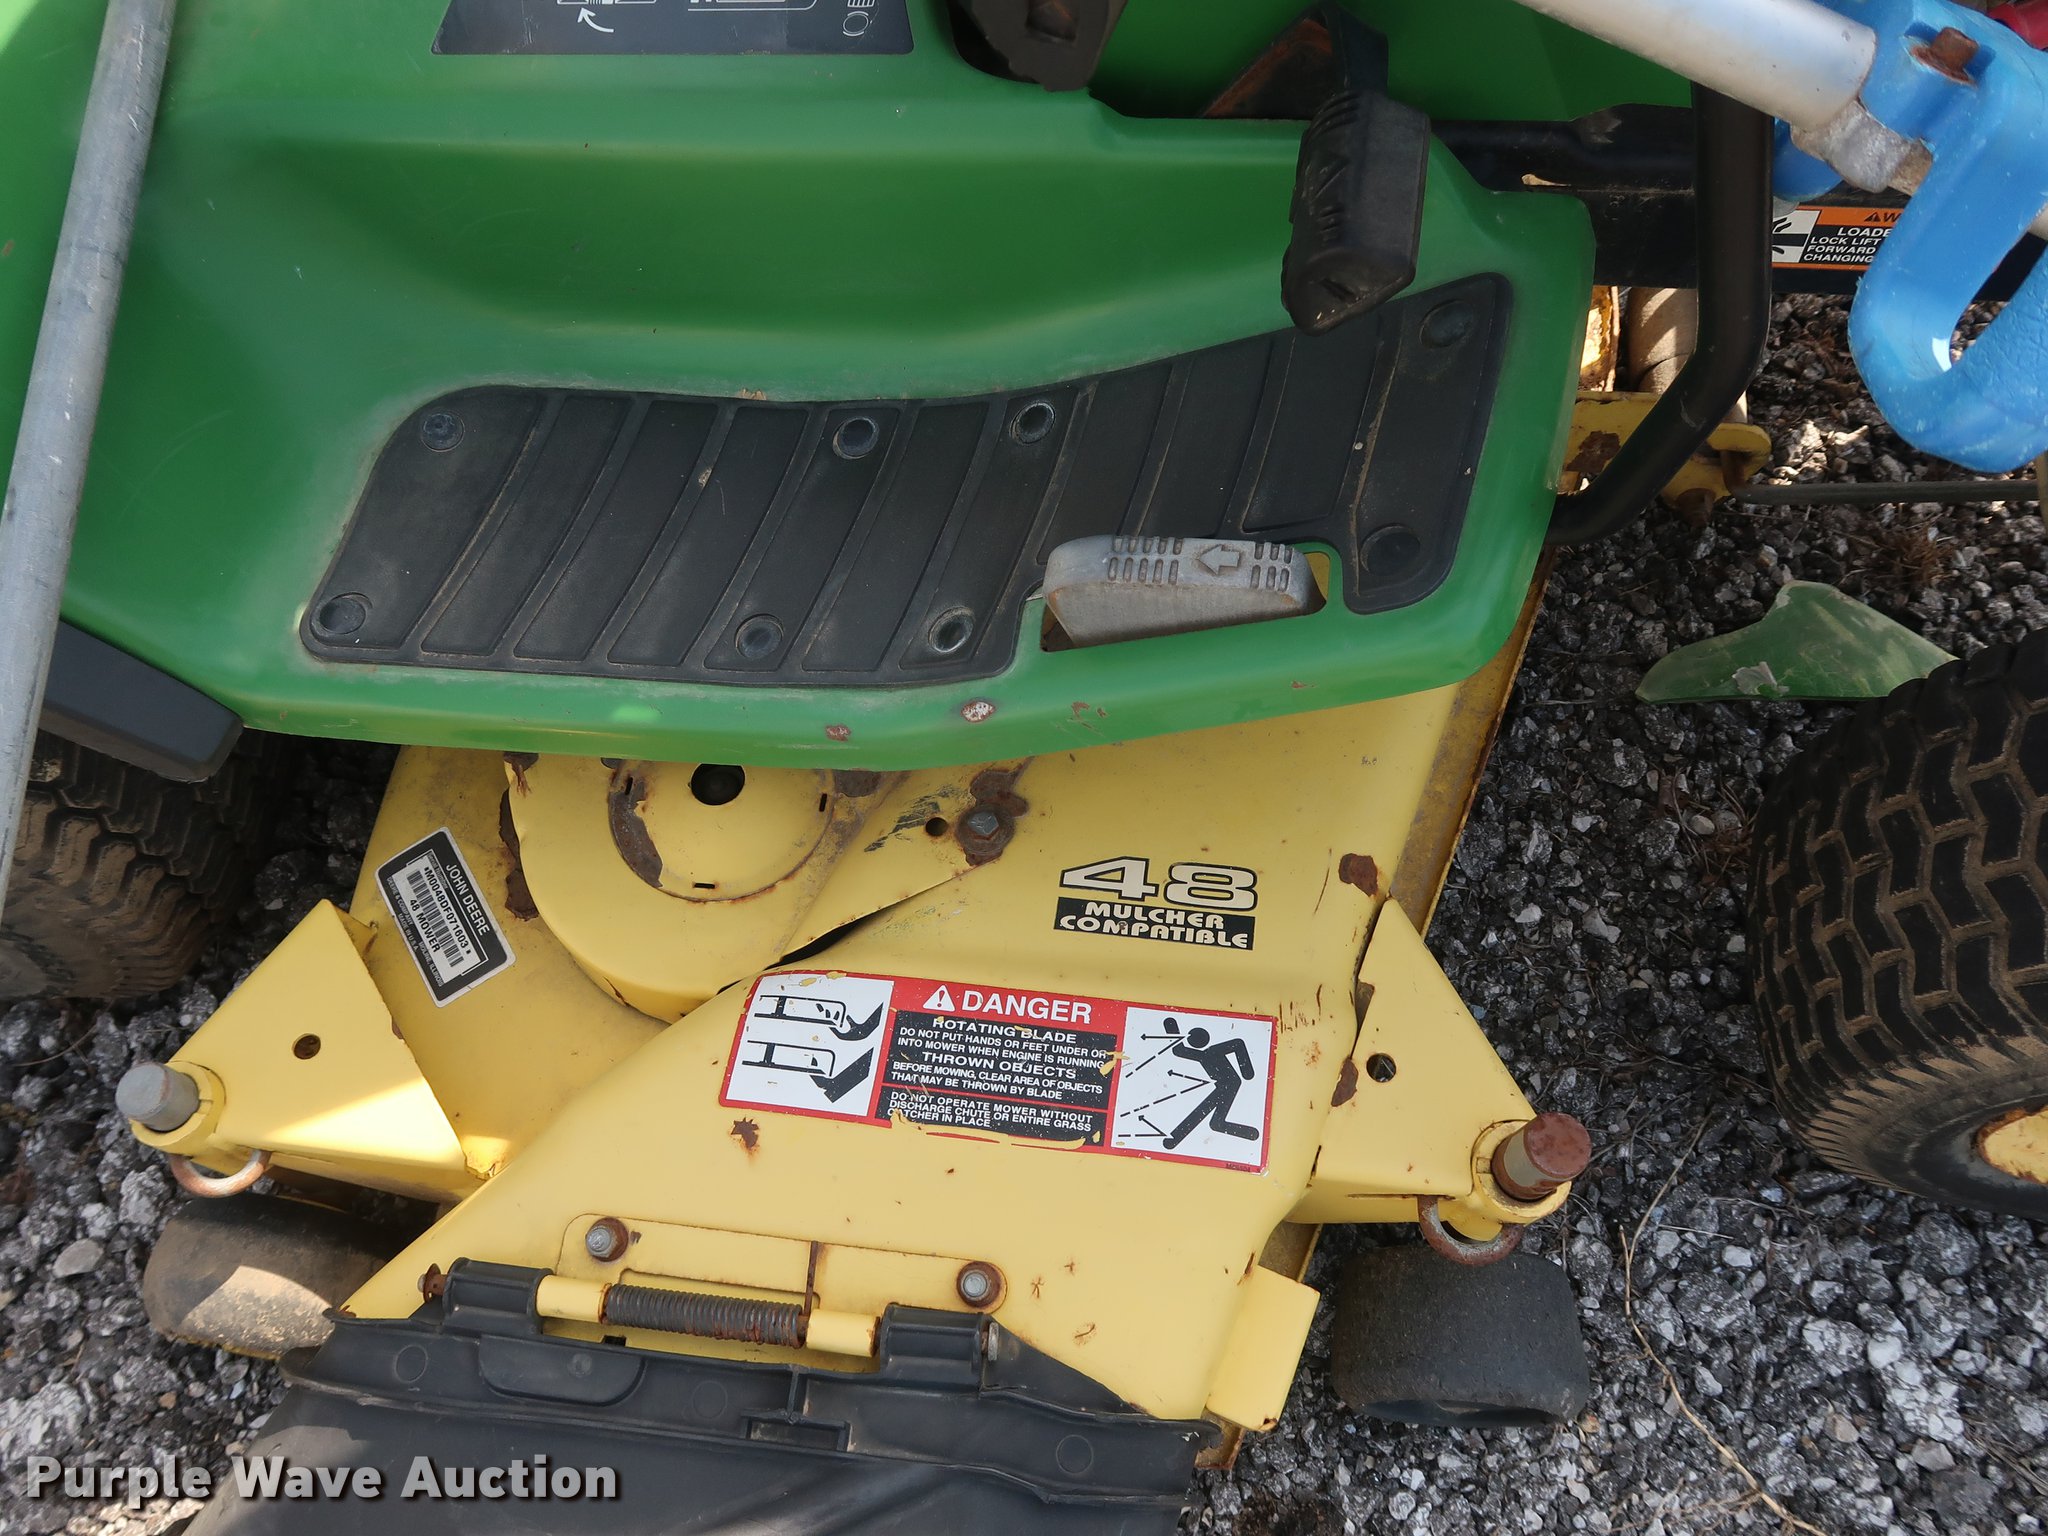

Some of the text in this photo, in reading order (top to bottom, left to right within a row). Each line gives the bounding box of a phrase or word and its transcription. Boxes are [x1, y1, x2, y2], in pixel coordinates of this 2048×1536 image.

[1806, 245, 1876, 254] FORWARD
[1811, 237, 1881, 246] LOCK LIFT
[1803, 253, 1874, 262] CHANGING
[1060, 856, 1258, 912] 48
[397, 899, 414, 926] COMPANY
[446, 864, 490, 936] JOHN DEERE
[398, 912, 408, 932] MADE
[410, 899, 441, 953] 48 MOWER
[1085, 902, 1224, 929] MULCHER
[1060, 915, 1248, 948] COMPATIBLE
[962, 990, 1092, 1024] DANGER
[900, 1027, 916, 1036] DO
[918, 1030, 940, 1038] NOT
[942, 1032, 963, 1041] PUT
[965, 1035, 1001, 1046] HANDS
[1004, 1039, 1019, 1048] OR
[1022, 1042, 1049, 1052] FEET
[1051, 1045, 1088, 1057] UNDER
[1021, 1028, 1077, 1043] BLADE
[898, 1038, 1104, 1069] INTO MOWER WHEN ENGINE IS RUNNING
[922, 1052, 1076, 1079] THROWN OBJECTS
[891, 1072, 1062, 1100] THAT MAY BE THROWN BY BLADE
[893, 1061, 1103, 1094] BEFORE MOWING, CLEAR AREA OF OBJECTS
[888, 1108, 939, 1120] CTCHER
[955, 1116, 991, 1127] PLACE
[889, 1100, 1091, 1132] DISCHARGE CHUTE OR ENTIRE GRASS
[891, 1092, 1093, 1123] DO NOT OPERATE MOWER WITHOUT
